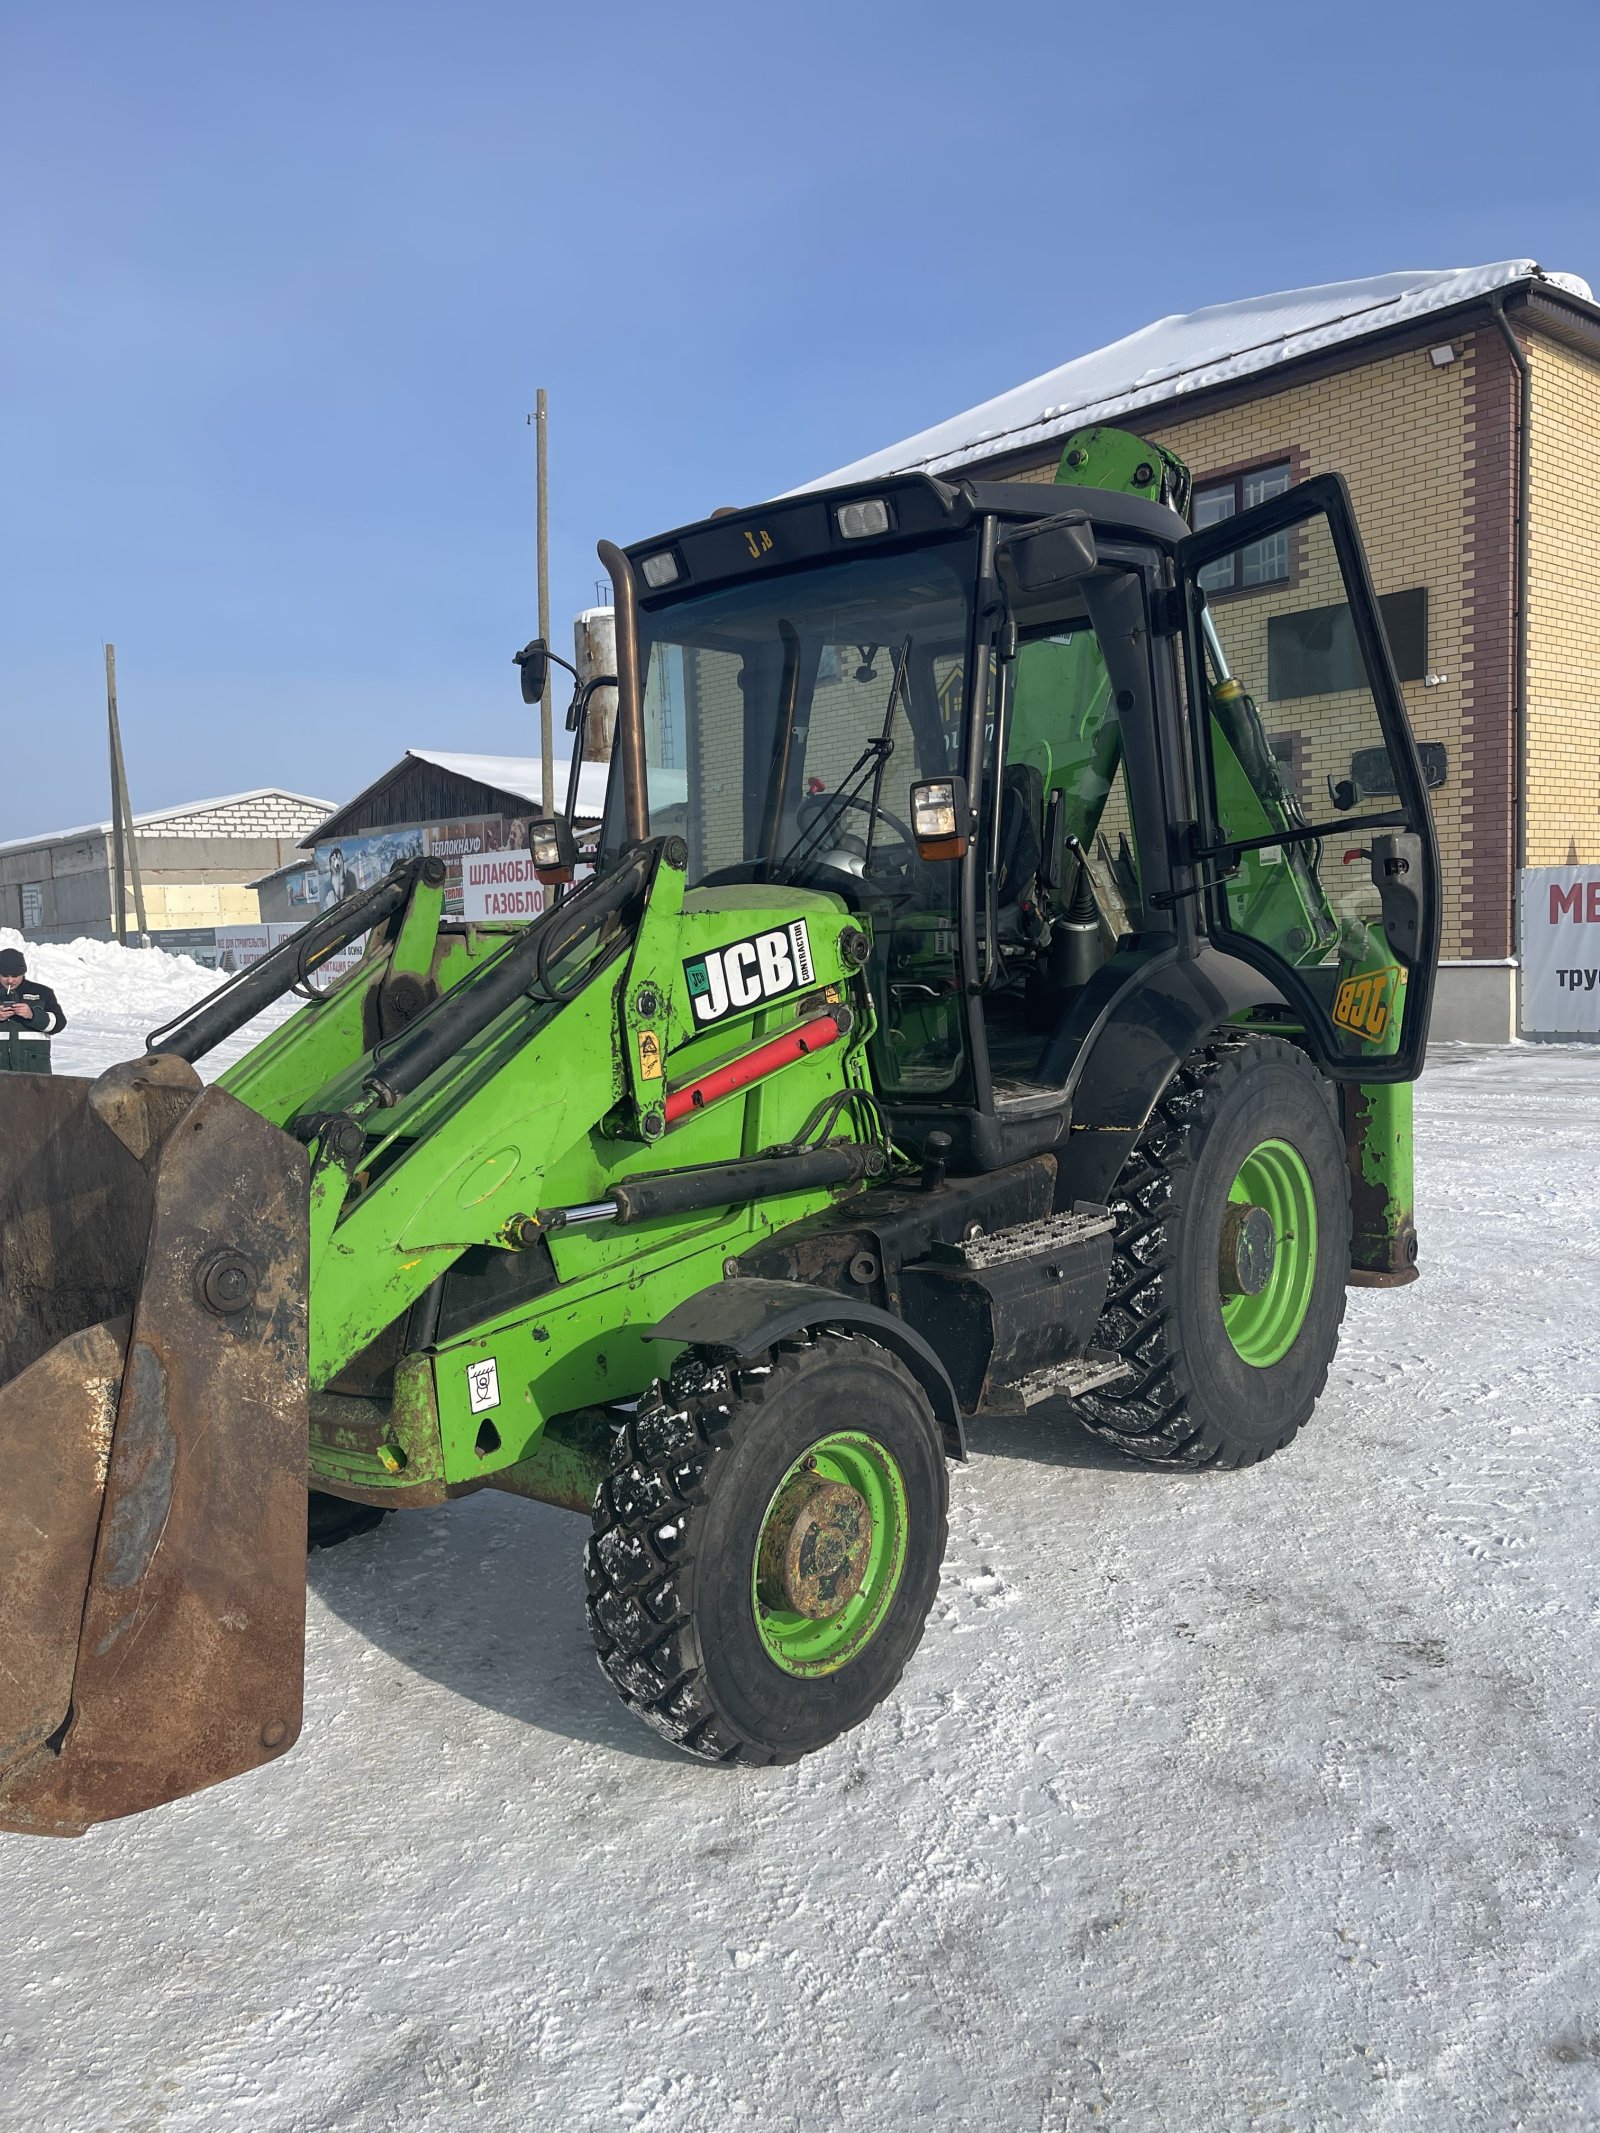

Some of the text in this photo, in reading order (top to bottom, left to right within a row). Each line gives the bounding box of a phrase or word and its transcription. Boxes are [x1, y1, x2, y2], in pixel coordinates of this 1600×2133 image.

[431, 836, 482, 857] ТЕПЛОКНАУФ
[485, 890, 545, 915] ГАЗОБЛО
[794, 923, 811, 982] CONTRACTOR
[691, 970, 706, 989] JCB
[693, 931, 794, 1021] JCB
[1556, 969, 1600, 992] тру
